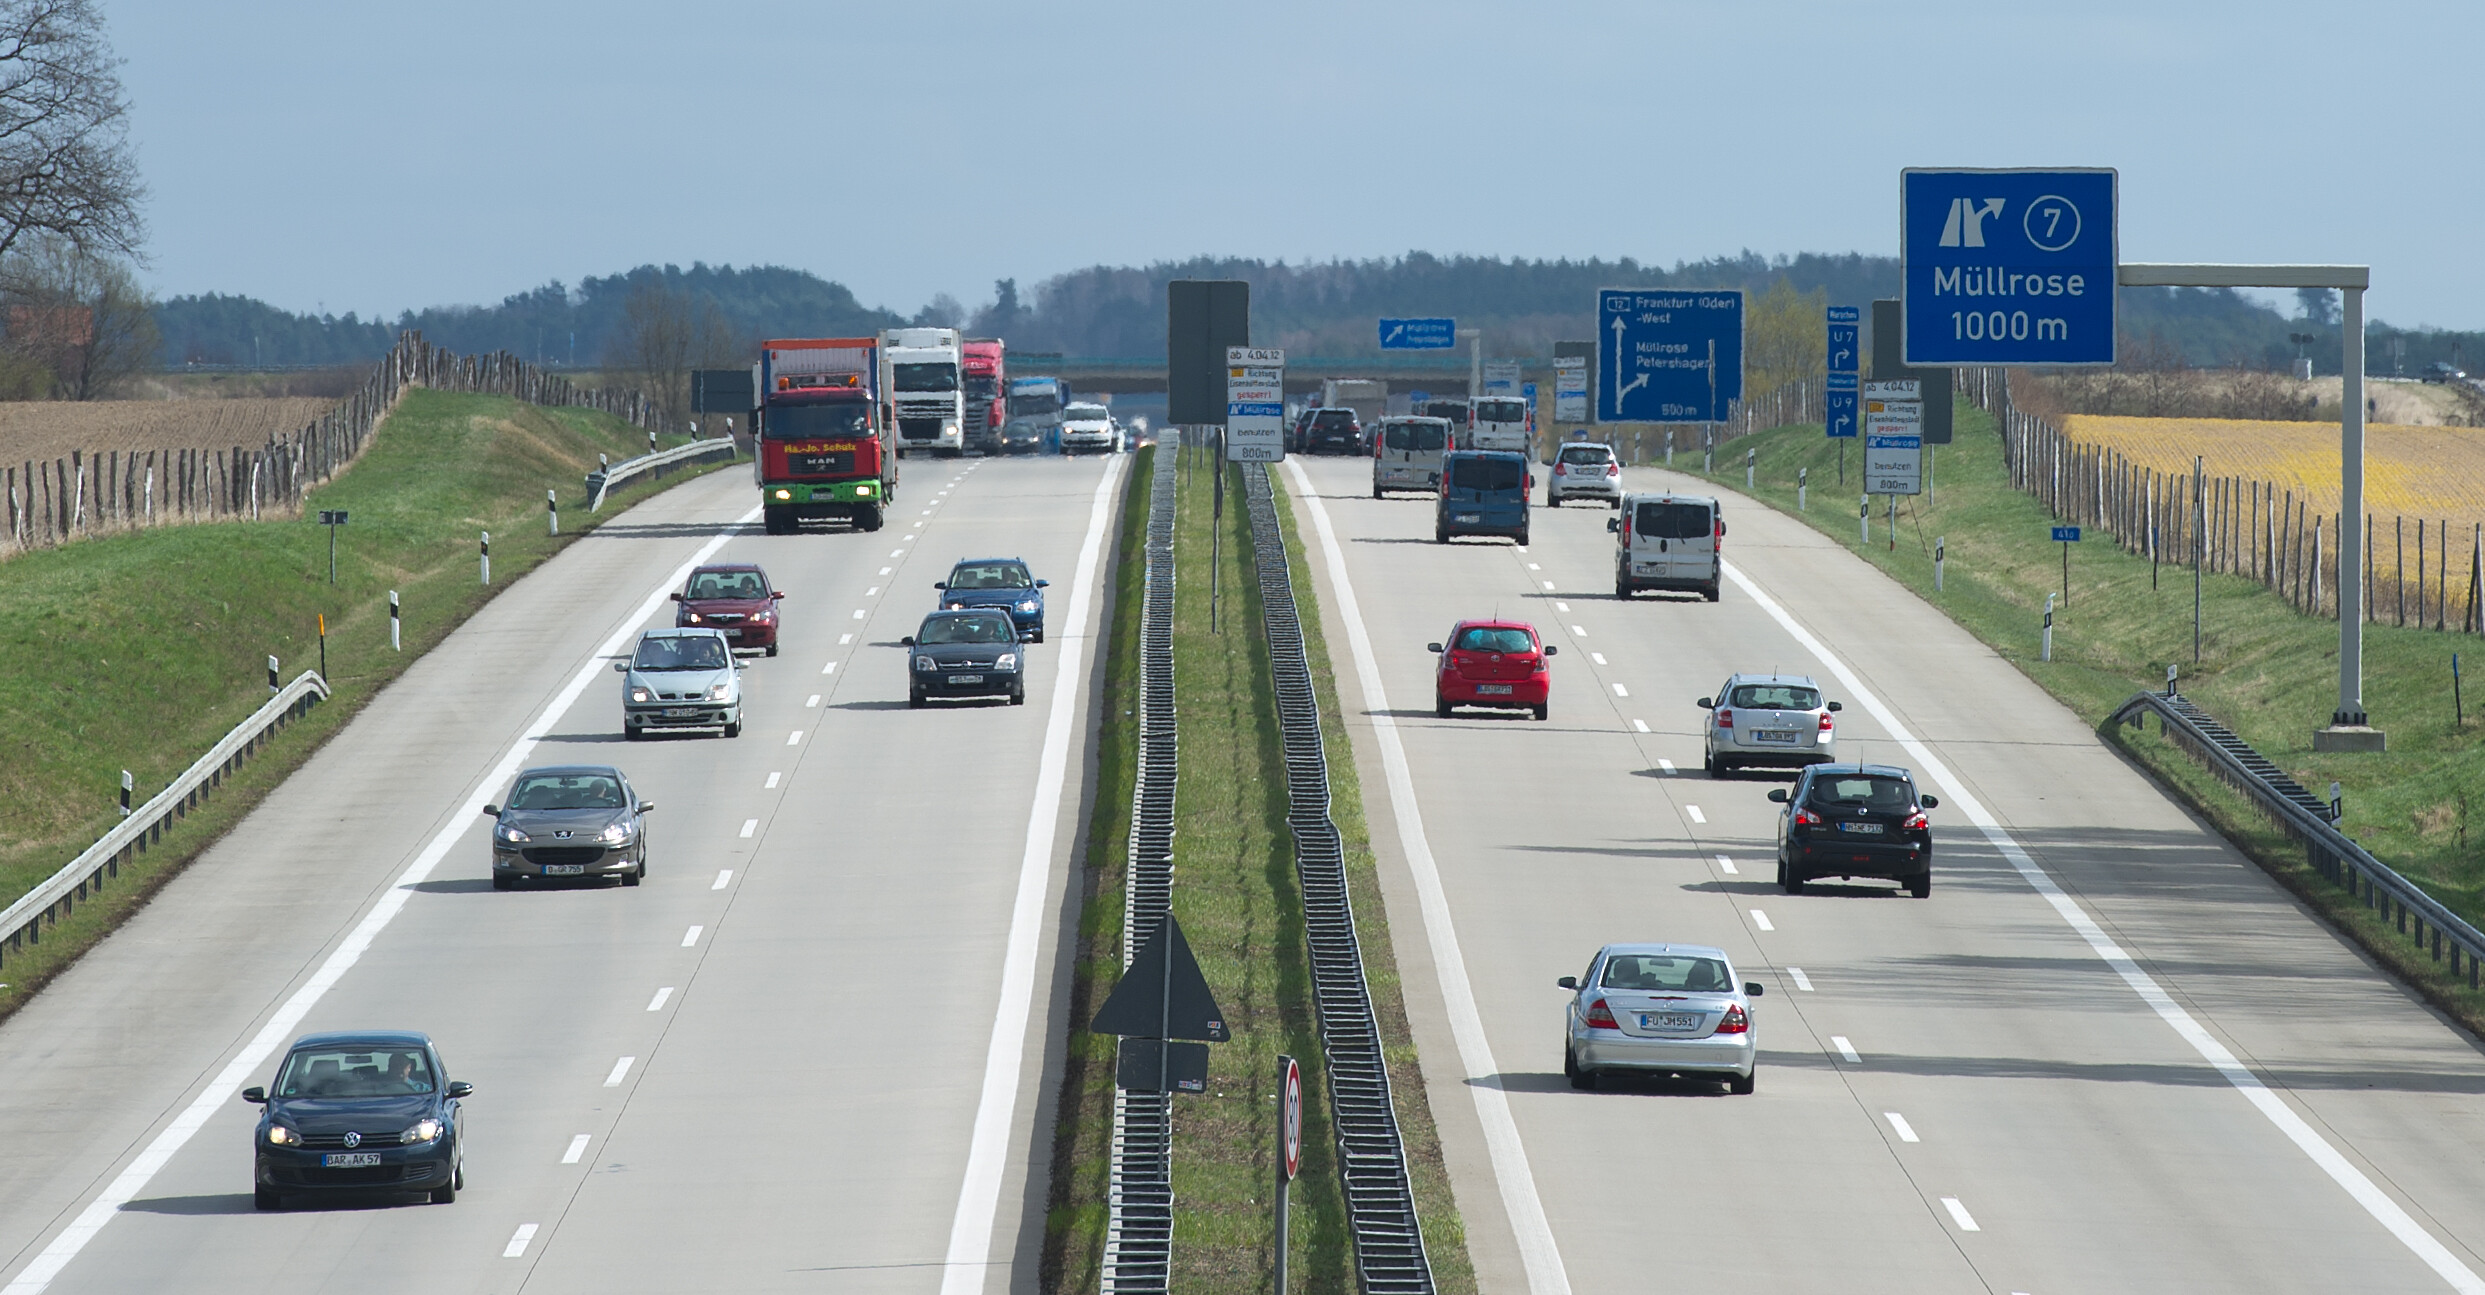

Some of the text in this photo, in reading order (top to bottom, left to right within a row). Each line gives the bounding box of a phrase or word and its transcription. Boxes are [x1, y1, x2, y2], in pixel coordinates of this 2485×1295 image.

[2043, 208, 2061, 238] 7
[1934, 266, 2085, 296] Müllrose
[1614, 300, 1625, 310] 12
[1635, 295, 1736, 310] Frankfurt (Oder)
[1952, 311, 2029, 341] 1000
[1635, 341, 1689, 354] Müllrose
[1230, 351, 1242, 360] ab
[1237, 428, 1276, 437] benutzen
[823, 442, 857, 452] Schulz
[807, 457, 835, 465] MAN
[1875, 461, 1912, 470] benutzen
[1646, 1015, 1659, 1026] FU
[1288, 1094, 1298, 1145] 80
[327, 1154, 380, 1166] BAR AK 57
